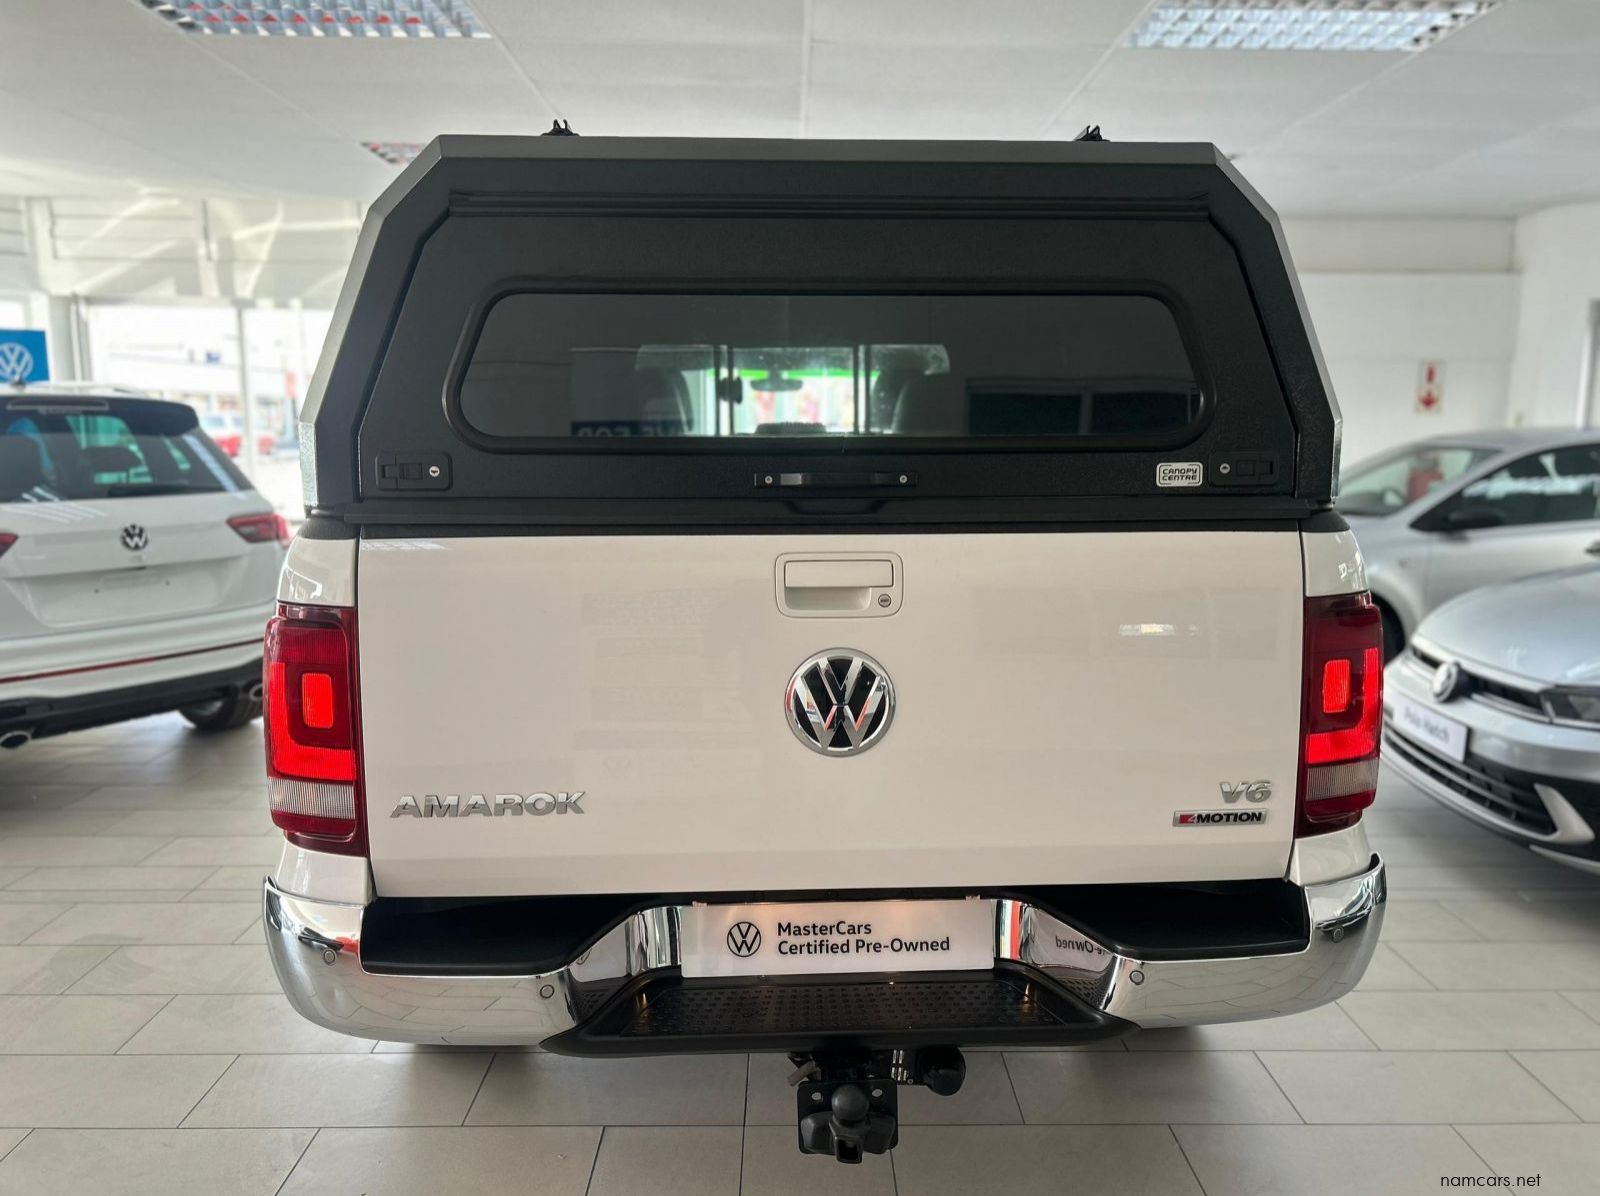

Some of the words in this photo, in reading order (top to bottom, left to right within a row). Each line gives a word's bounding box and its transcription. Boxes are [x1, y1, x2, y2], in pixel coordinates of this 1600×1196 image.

[1220, 779, 1272, 804] V6
[389, 791, 586, 818] AMAROK
[777, 920, 872, 936] MasterCars
[777, 939, 850, 955] Certified
[855, 936, 950, 953] Pre-Owned
